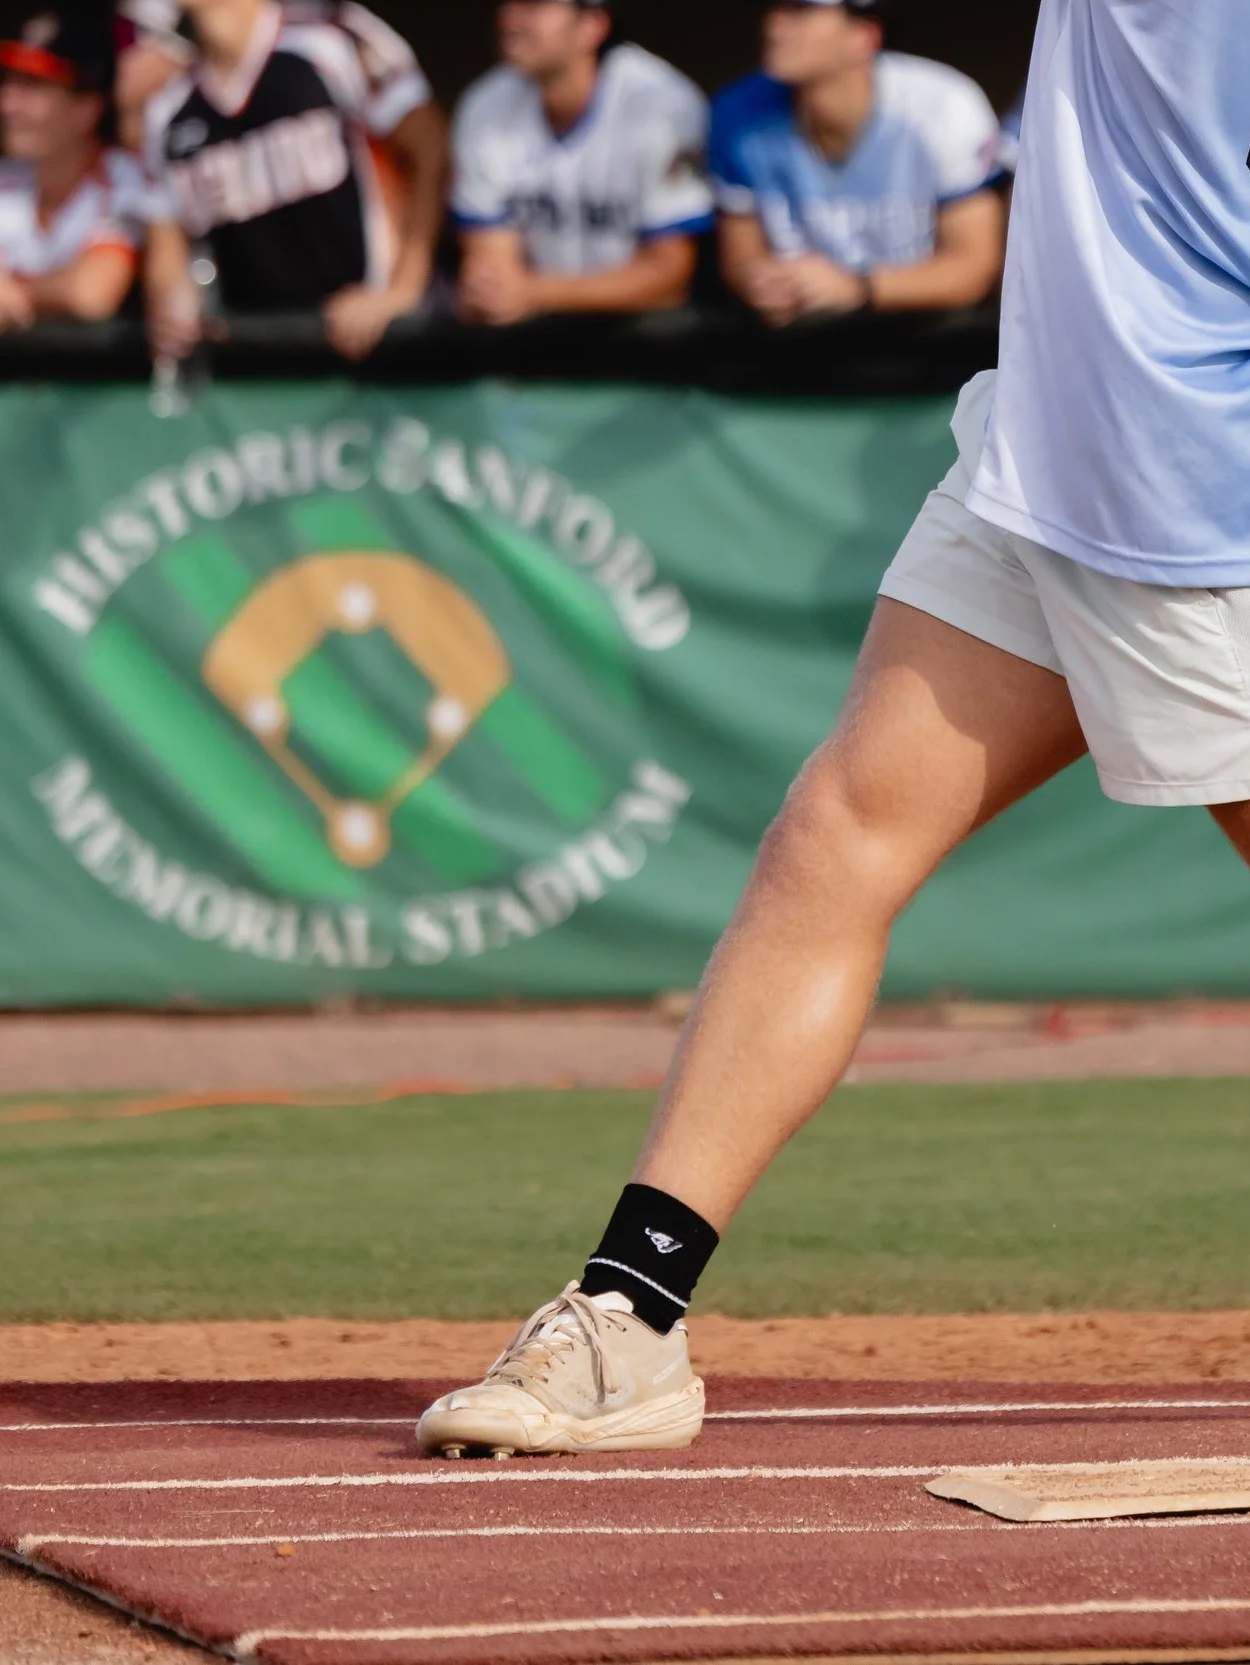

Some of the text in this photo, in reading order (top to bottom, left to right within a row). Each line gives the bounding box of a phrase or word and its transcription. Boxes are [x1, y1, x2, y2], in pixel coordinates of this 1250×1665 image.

[34, 420, 373, 634] HISTORIC
[30, 754, 692, 968] MEMORIAL STADIUM
